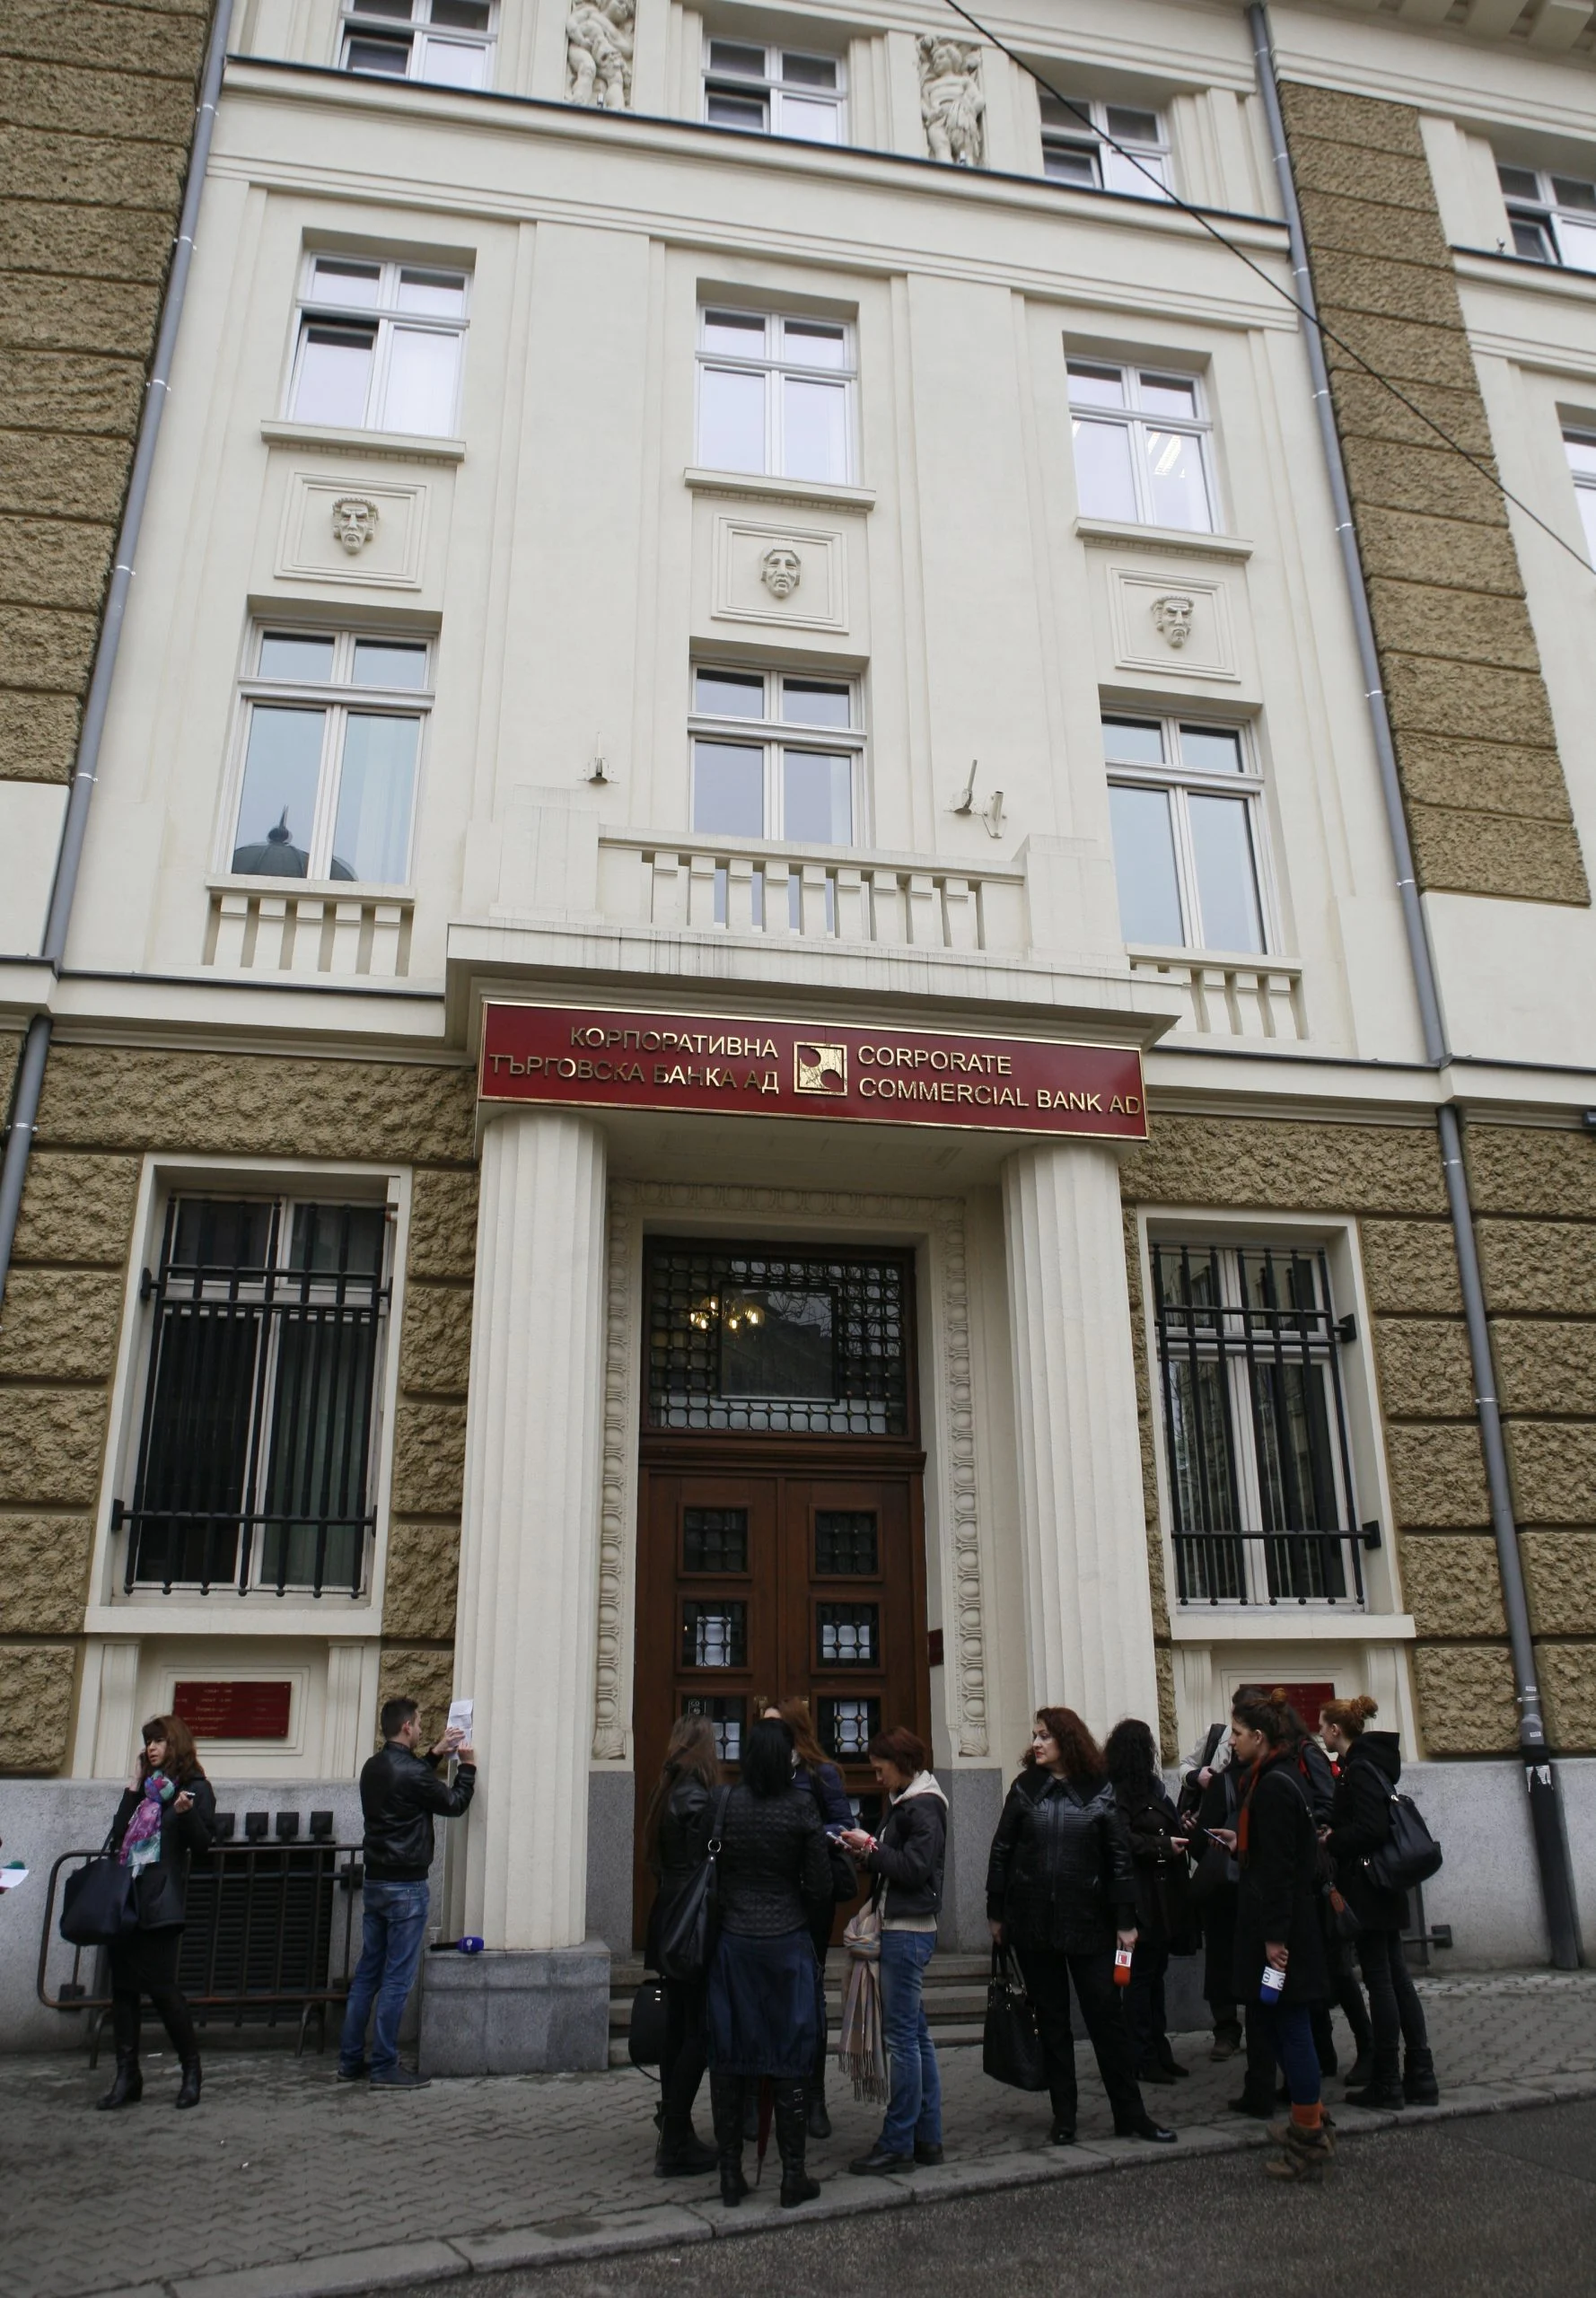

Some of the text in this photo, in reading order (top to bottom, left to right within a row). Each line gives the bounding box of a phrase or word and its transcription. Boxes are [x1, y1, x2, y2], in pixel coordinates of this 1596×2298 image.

[571, 1027, 778, 1058] КОРПОРАТИВНА
[489, 1054, 779, 1095] ТЪРГОВСКА БАНКА АД
[858, 1045, 1013, 1075] CORPORATE
[859, 1077, 1141, 1115] COMMERCIAL BANK AD
